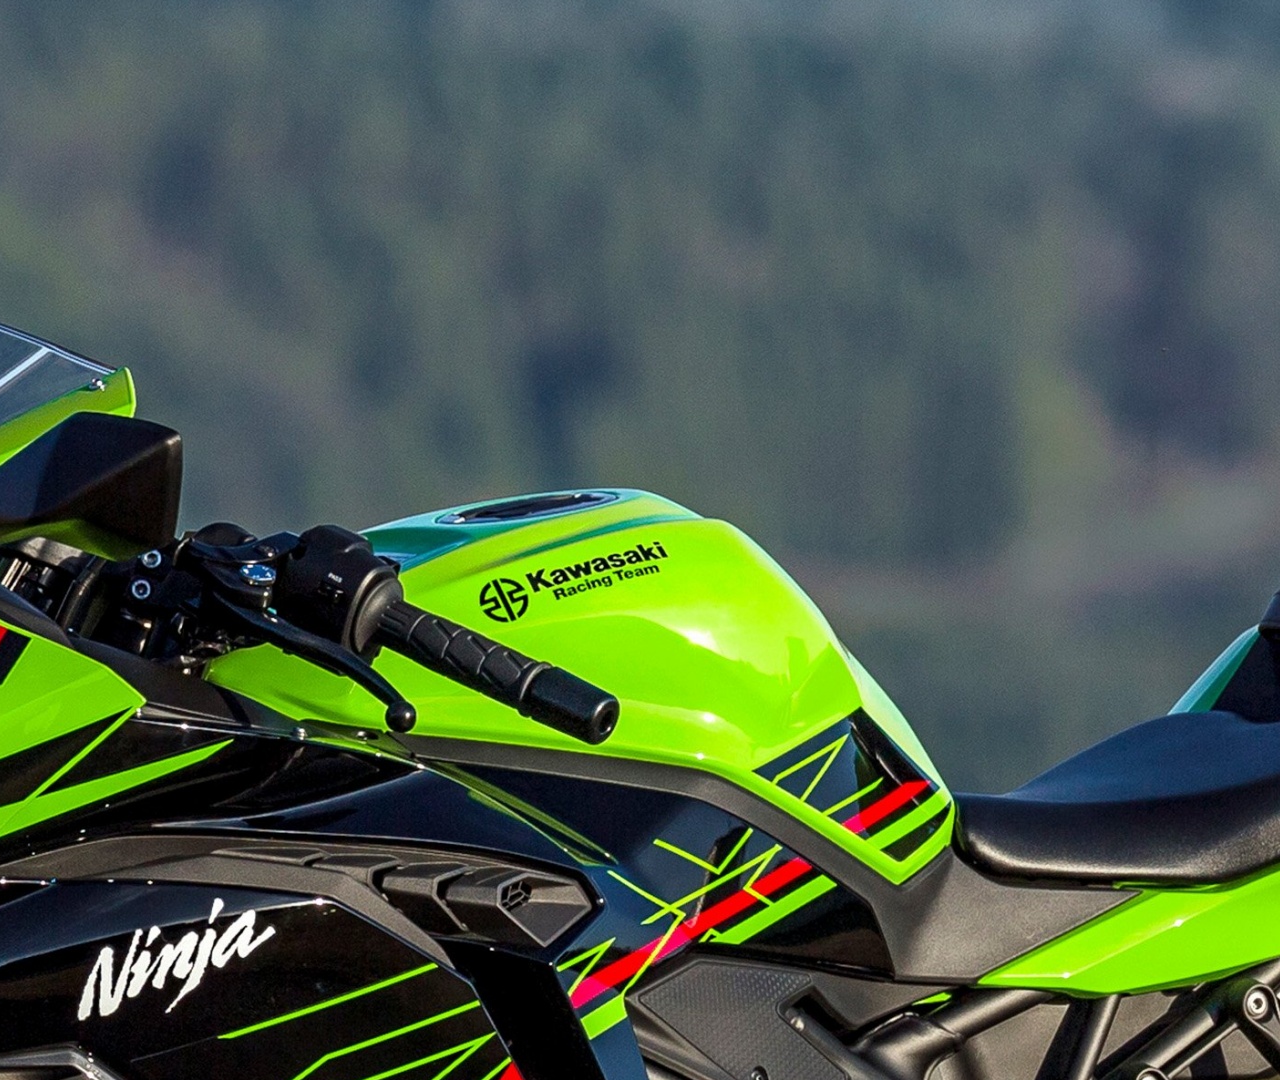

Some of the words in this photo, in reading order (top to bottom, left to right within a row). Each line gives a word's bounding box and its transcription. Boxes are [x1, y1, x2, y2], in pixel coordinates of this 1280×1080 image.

[525, 541, 668, 593] Kawasaki
[553, 575, 613, 601] Racing
[613, 564, 660, 582] Team
[77, 897, 276, 1021] Ninja
